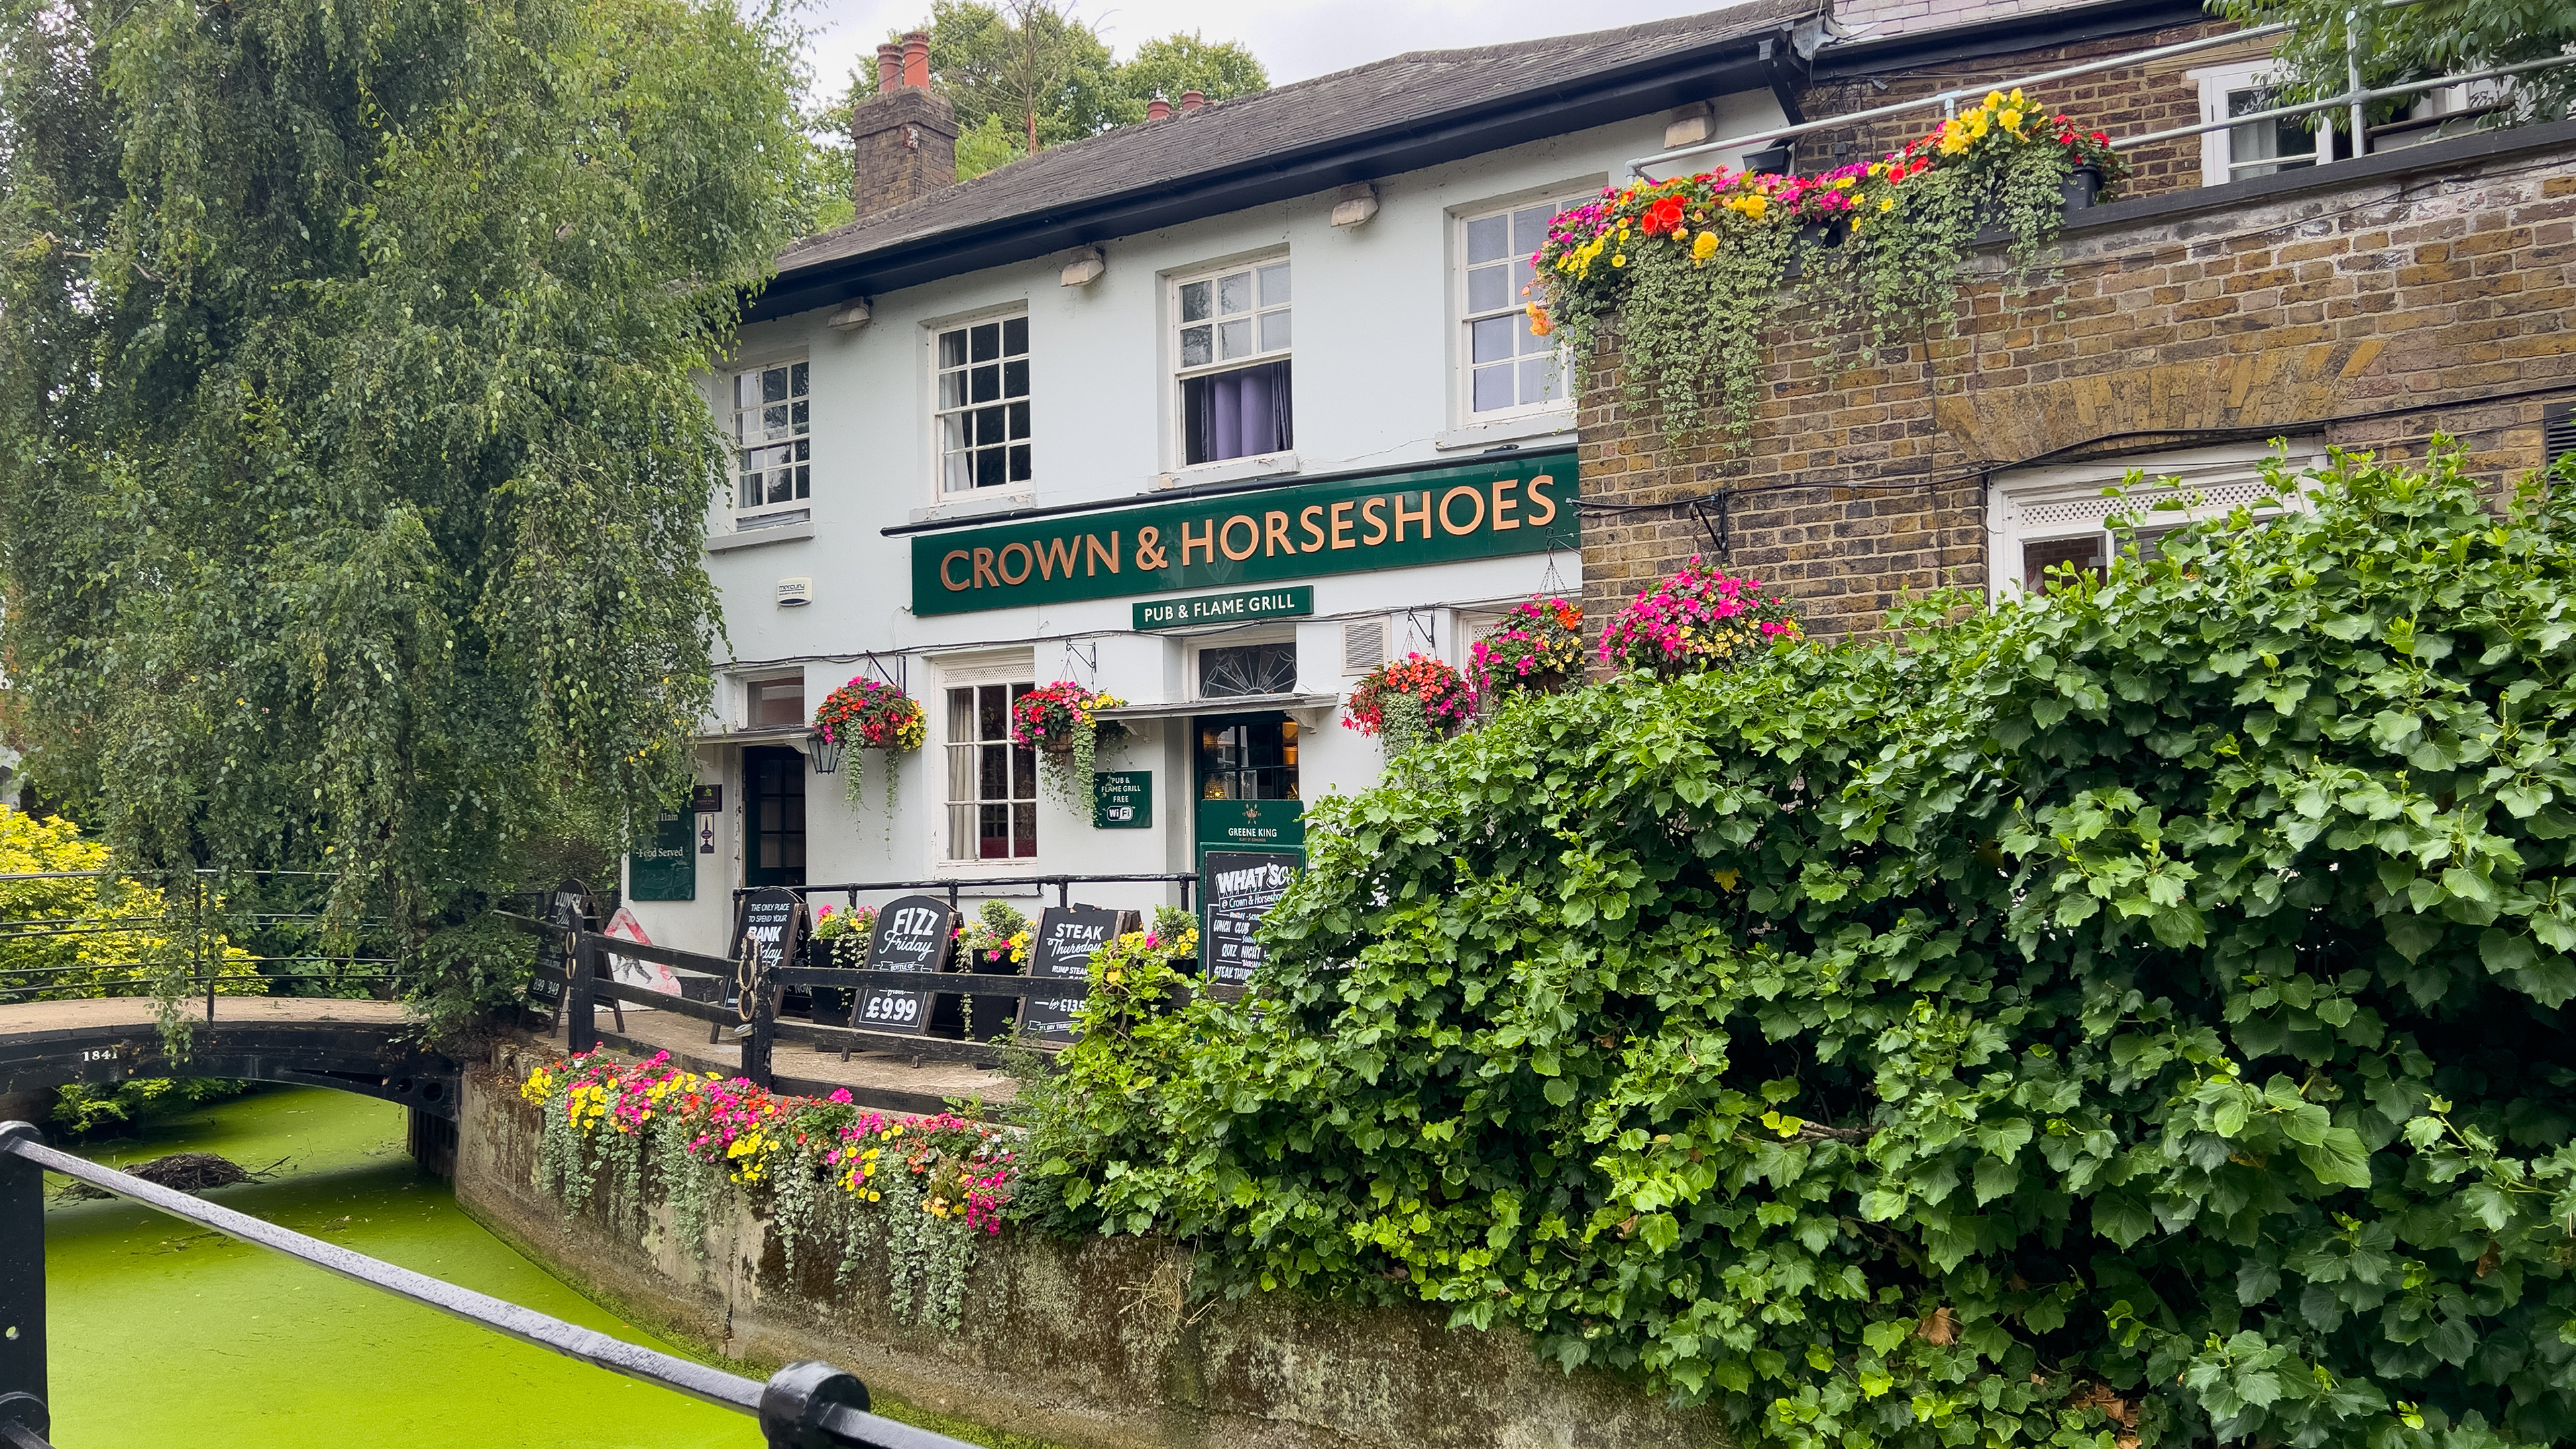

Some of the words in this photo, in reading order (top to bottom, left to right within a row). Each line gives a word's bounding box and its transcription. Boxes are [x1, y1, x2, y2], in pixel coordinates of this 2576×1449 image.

[941, 530, 1120, 592] CROWN
[1136, 526, 1169, 571] &
[1181, 475, 1556, 566] HORSESHOES
[1144, 606, 1173, 623] PUB
[1178, 604, 1189, 619] &
[1194, 598, 1244, 617] FLAME
[1248, 594, 1295, 612] GRILL
[1228, 827, 1256, 837] GREENE
[1258, 828, 1277, 837] KING
[658, 846, 684, 857] Served
[751, 903, 761, 912] THE
[761, 903, 775, 912] ONLY
[774, 903, 790, 911] PLACE
[1222, 900, 1228, 909] @
[1229, 898, 1248, 908] Crown
[1248, 895, 1254, 905] &
[773, 914, 788, 922] YOUR
[893, 907, 939, 936] FIZZ
[1055, 923, 1104, 941] STEAK
[1213, 919, 1232, 933] LUNCH
[1234, 922, 1250, 934] CLUB
[878, 929, 935, 962] Friday
[1222, 943, 1238, 957] QUIZ
[1240, 945, 1262, 960] NIGHT
[1051, 965, 1069, 974] RUMP
[1214, 965, 1234, 979] STEAK
[865, 997, 917, 1022] £9.99
[80, 1050, 118, 1061] 1841
